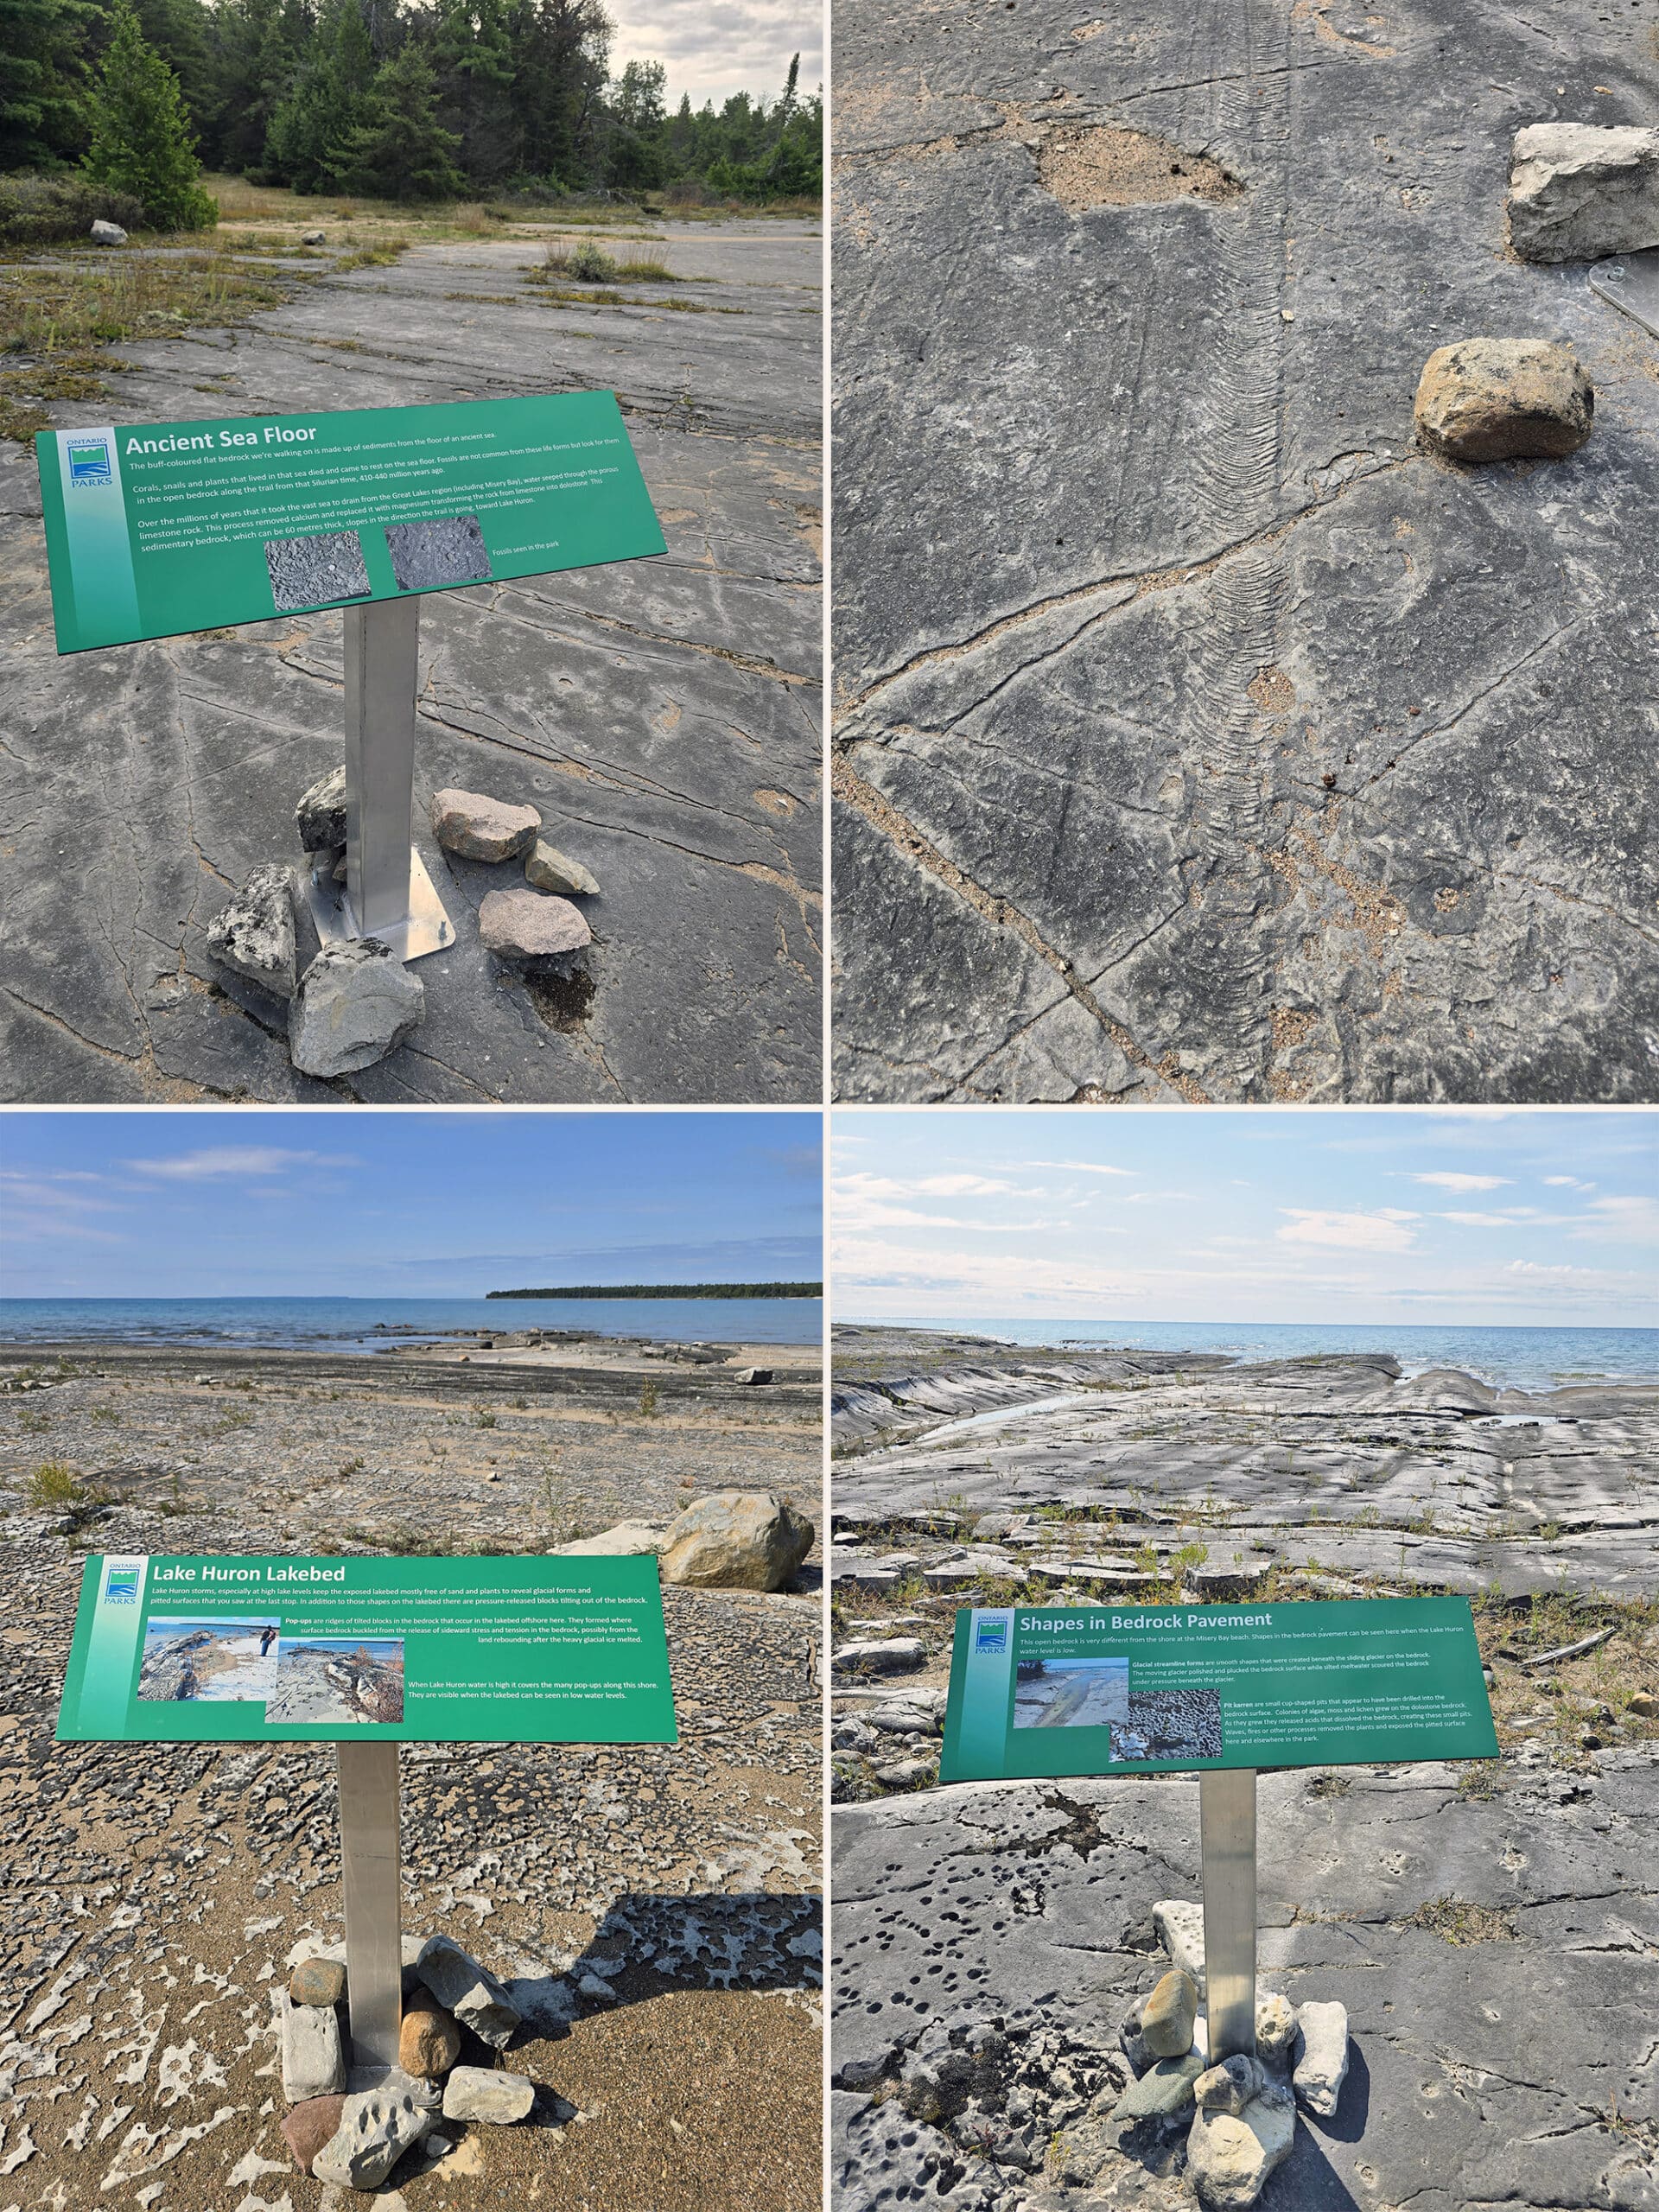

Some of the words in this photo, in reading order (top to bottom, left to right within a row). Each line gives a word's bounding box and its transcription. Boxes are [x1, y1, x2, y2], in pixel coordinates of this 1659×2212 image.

[67, 436, 107, 446] ONTARIO
[126, 433, 214, 455] Ancient
[220, 431, 258, 447] Sea
[263, 426, 316, 444] Floor
[147, 457, 202, 469] buff-coloured
[217, 453, 250, 462] bedrock
[273, 449, 303, 458] walking
[362, 441, 397, 450] sediments
[71, 477, 112, 488] PARKS
[163, 494, 185, 502] open
[185, 489, 219, 499] bedrock
[258, 484, 274, 492] trail
[311, 478, 339, 486] Silurian
[359, 473, 388, 481] 410-440
[141, 540, 194, 552] sedimentary
[232, 531, 257, 540] which
[296, 524, 323, 533] metres
[390, 512, 421, 521] direction
[475, 501, 499, 510] toward
[492, 548, 513, 556] Fossils
[545, 541, 560, 549] park
[153, 1565, 196, 1581] Lake
[201, 1566, 261, 1581] Huron
[266, 1565, 345, 1581] Lakebed
[1020, 1617, 1084, 1634] Shapes
[1090, 1616, 1106, 1630] in
[1111, 1614, 1182, 1629] Bedrock
[1187, 1613, 1273, 1627] Pavement
